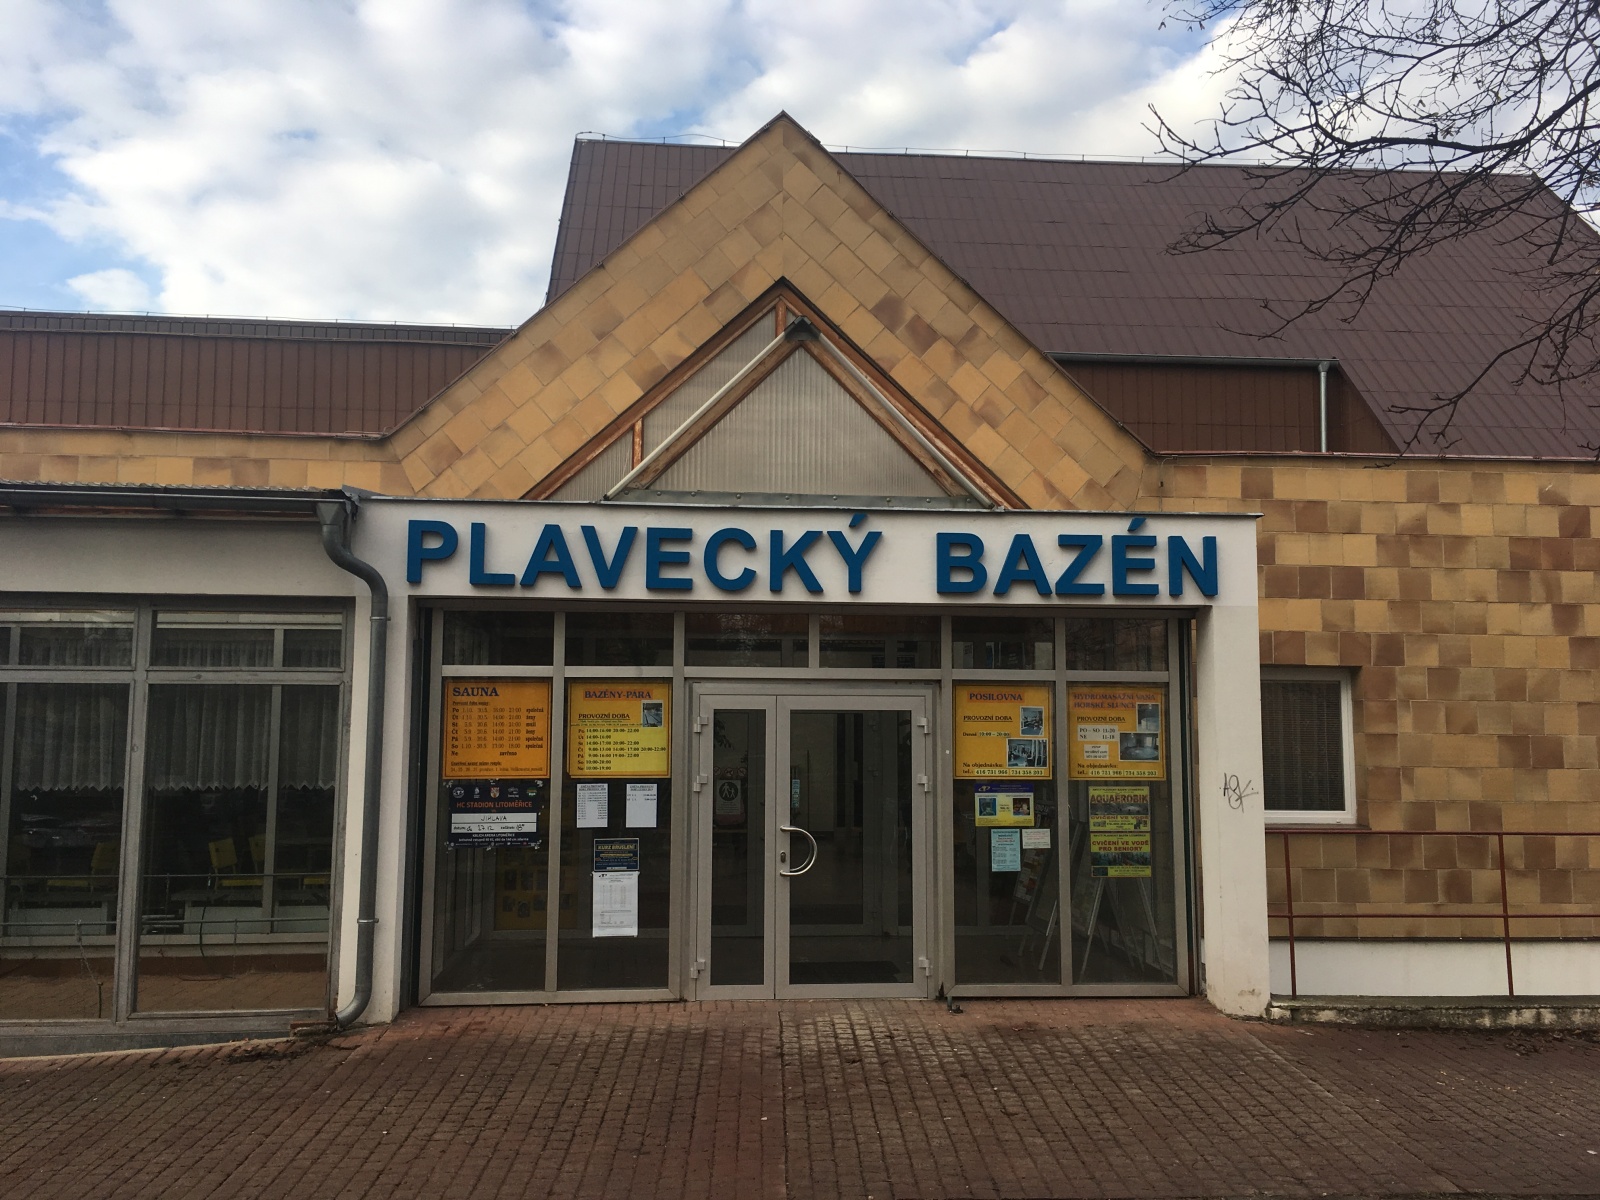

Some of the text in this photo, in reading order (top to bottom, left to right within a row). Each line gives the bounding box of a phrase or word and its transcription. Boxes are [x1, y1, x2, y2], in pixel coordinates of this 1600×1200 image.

[406, 513, 1219, 596] PLAVECKÝ BAZÉN
[453, 687, 499, 696] SAUNA
[585, 689, 651, 699] BAZÉNY-PÁRA
[969, 693, 1023, 701] POSILOVNA
[1091, 794, 1148, 803] AQUAEROBIK
[495, 800, 533, 808] LITOMĚŘICE
